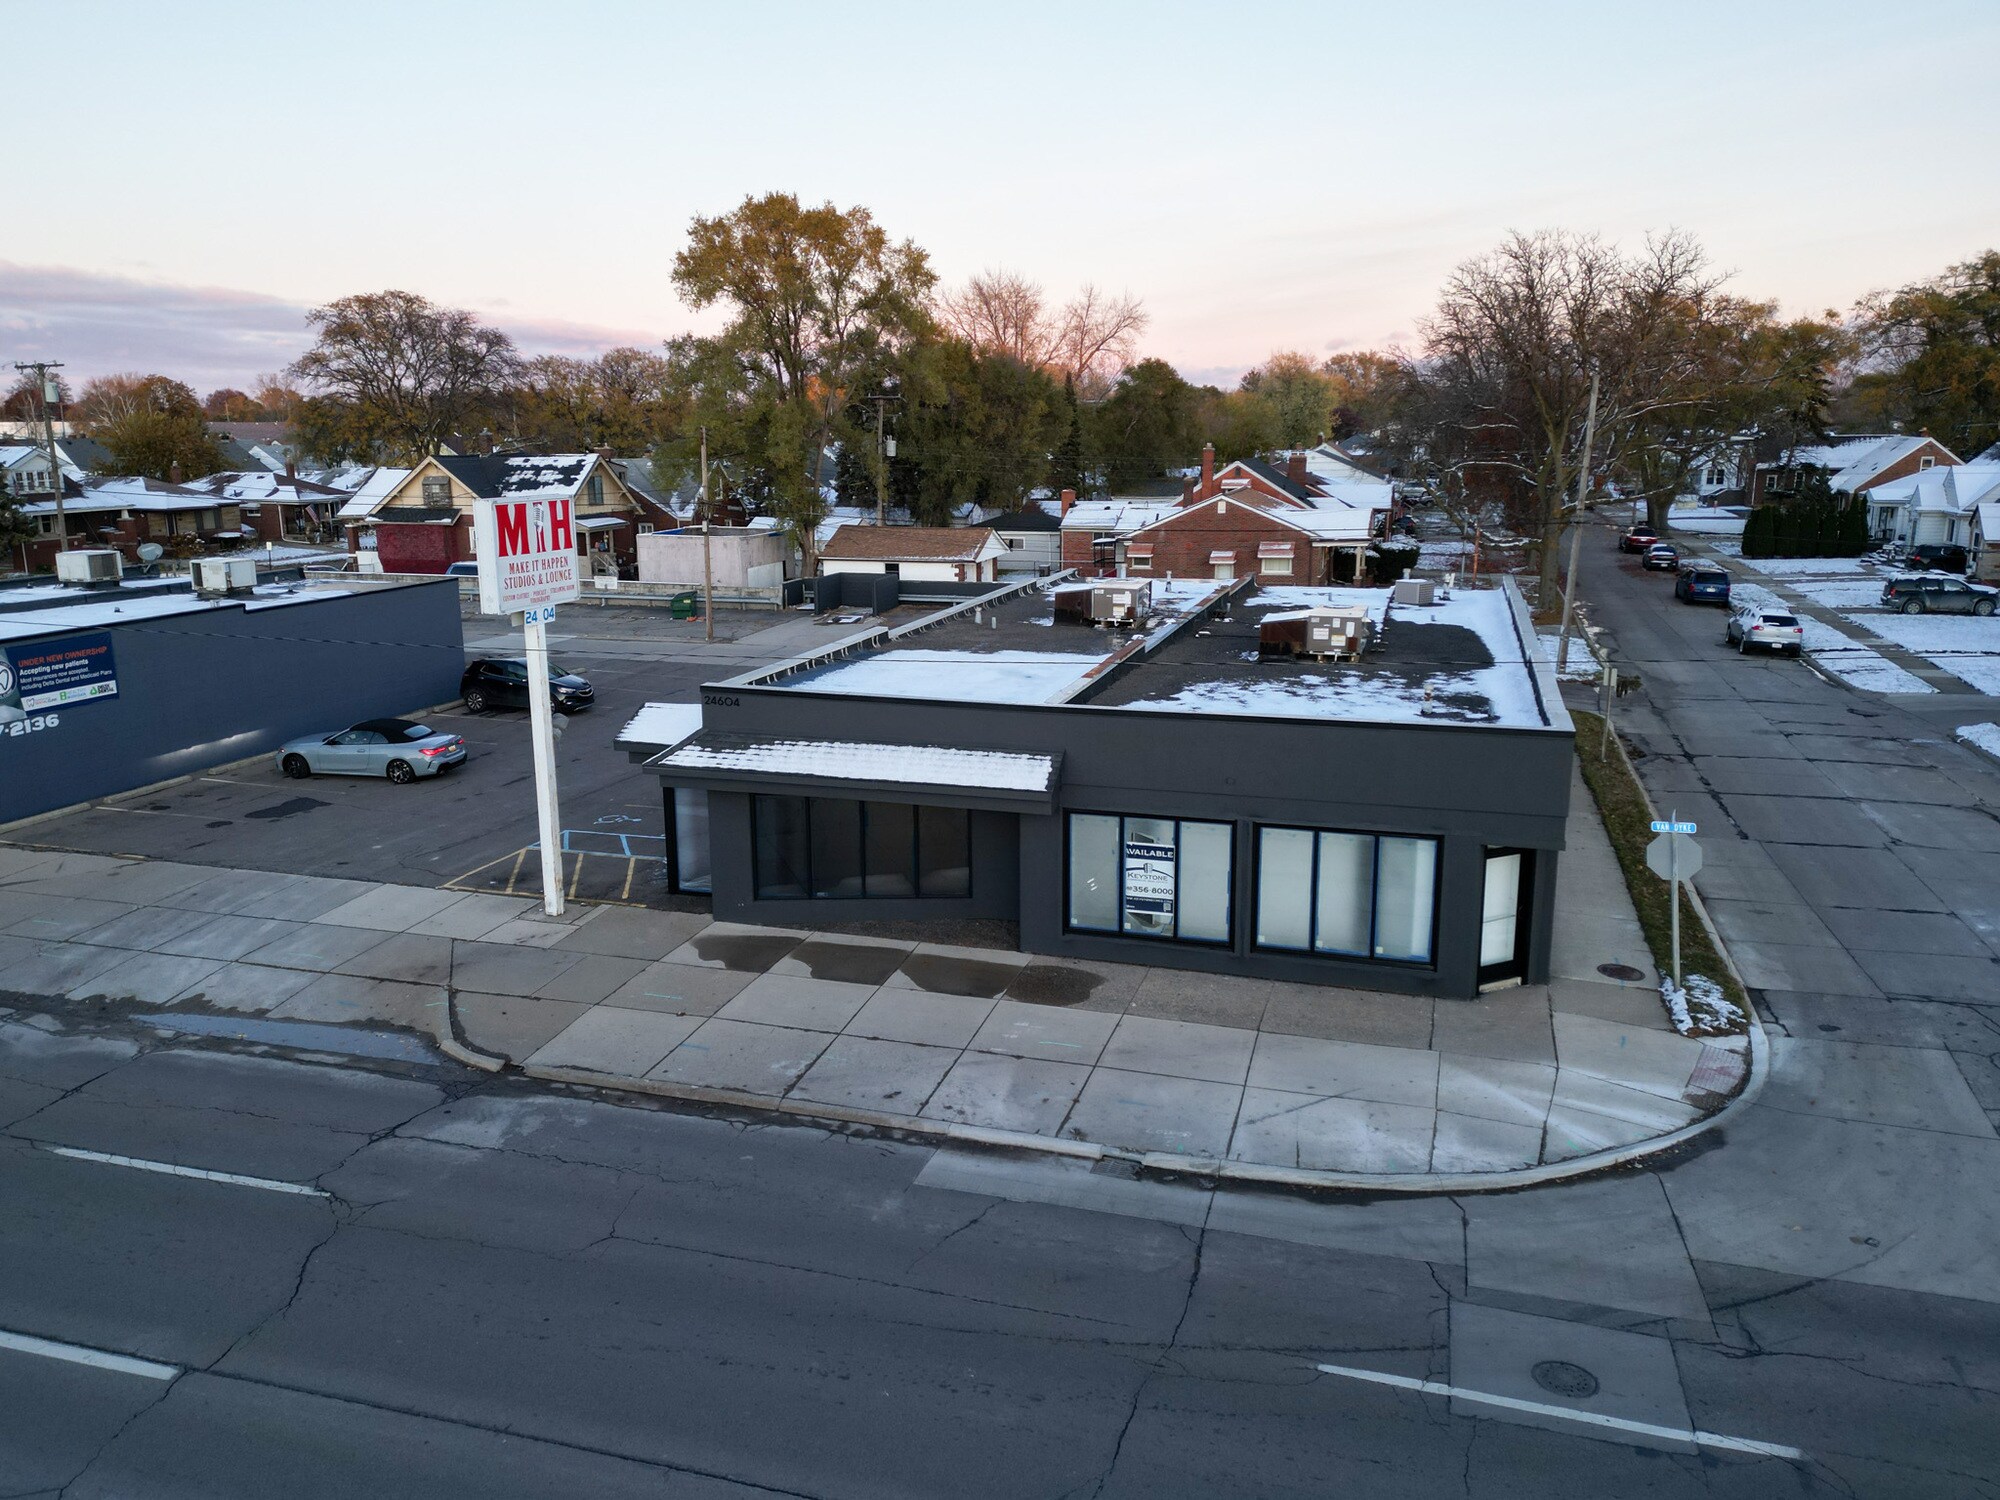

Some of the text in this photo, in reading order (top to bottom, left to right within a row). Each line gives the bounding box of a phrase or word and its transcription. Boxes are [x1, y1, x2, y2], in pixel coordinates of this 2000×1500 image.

[509, 556, 569, 574] MAKE IT HAPPEN
[504, 568, 572, 590] STUDIOS & LOUNGE
[525, 606, 555, 624] 24 04
[18, 656, 45, 667] UNDER
[46, 653, 63, 662] NEW
[64, 646, 107, 659] OWNERSHIP
[19, 658, 89, 675] Accepting new patients
[21, 682, 42, 690] including
[80, 671, 100, 680] Medicaid
[704, 695, 740, 706] 24604
[1656, 822, 1692, 832] VAN DYKE
